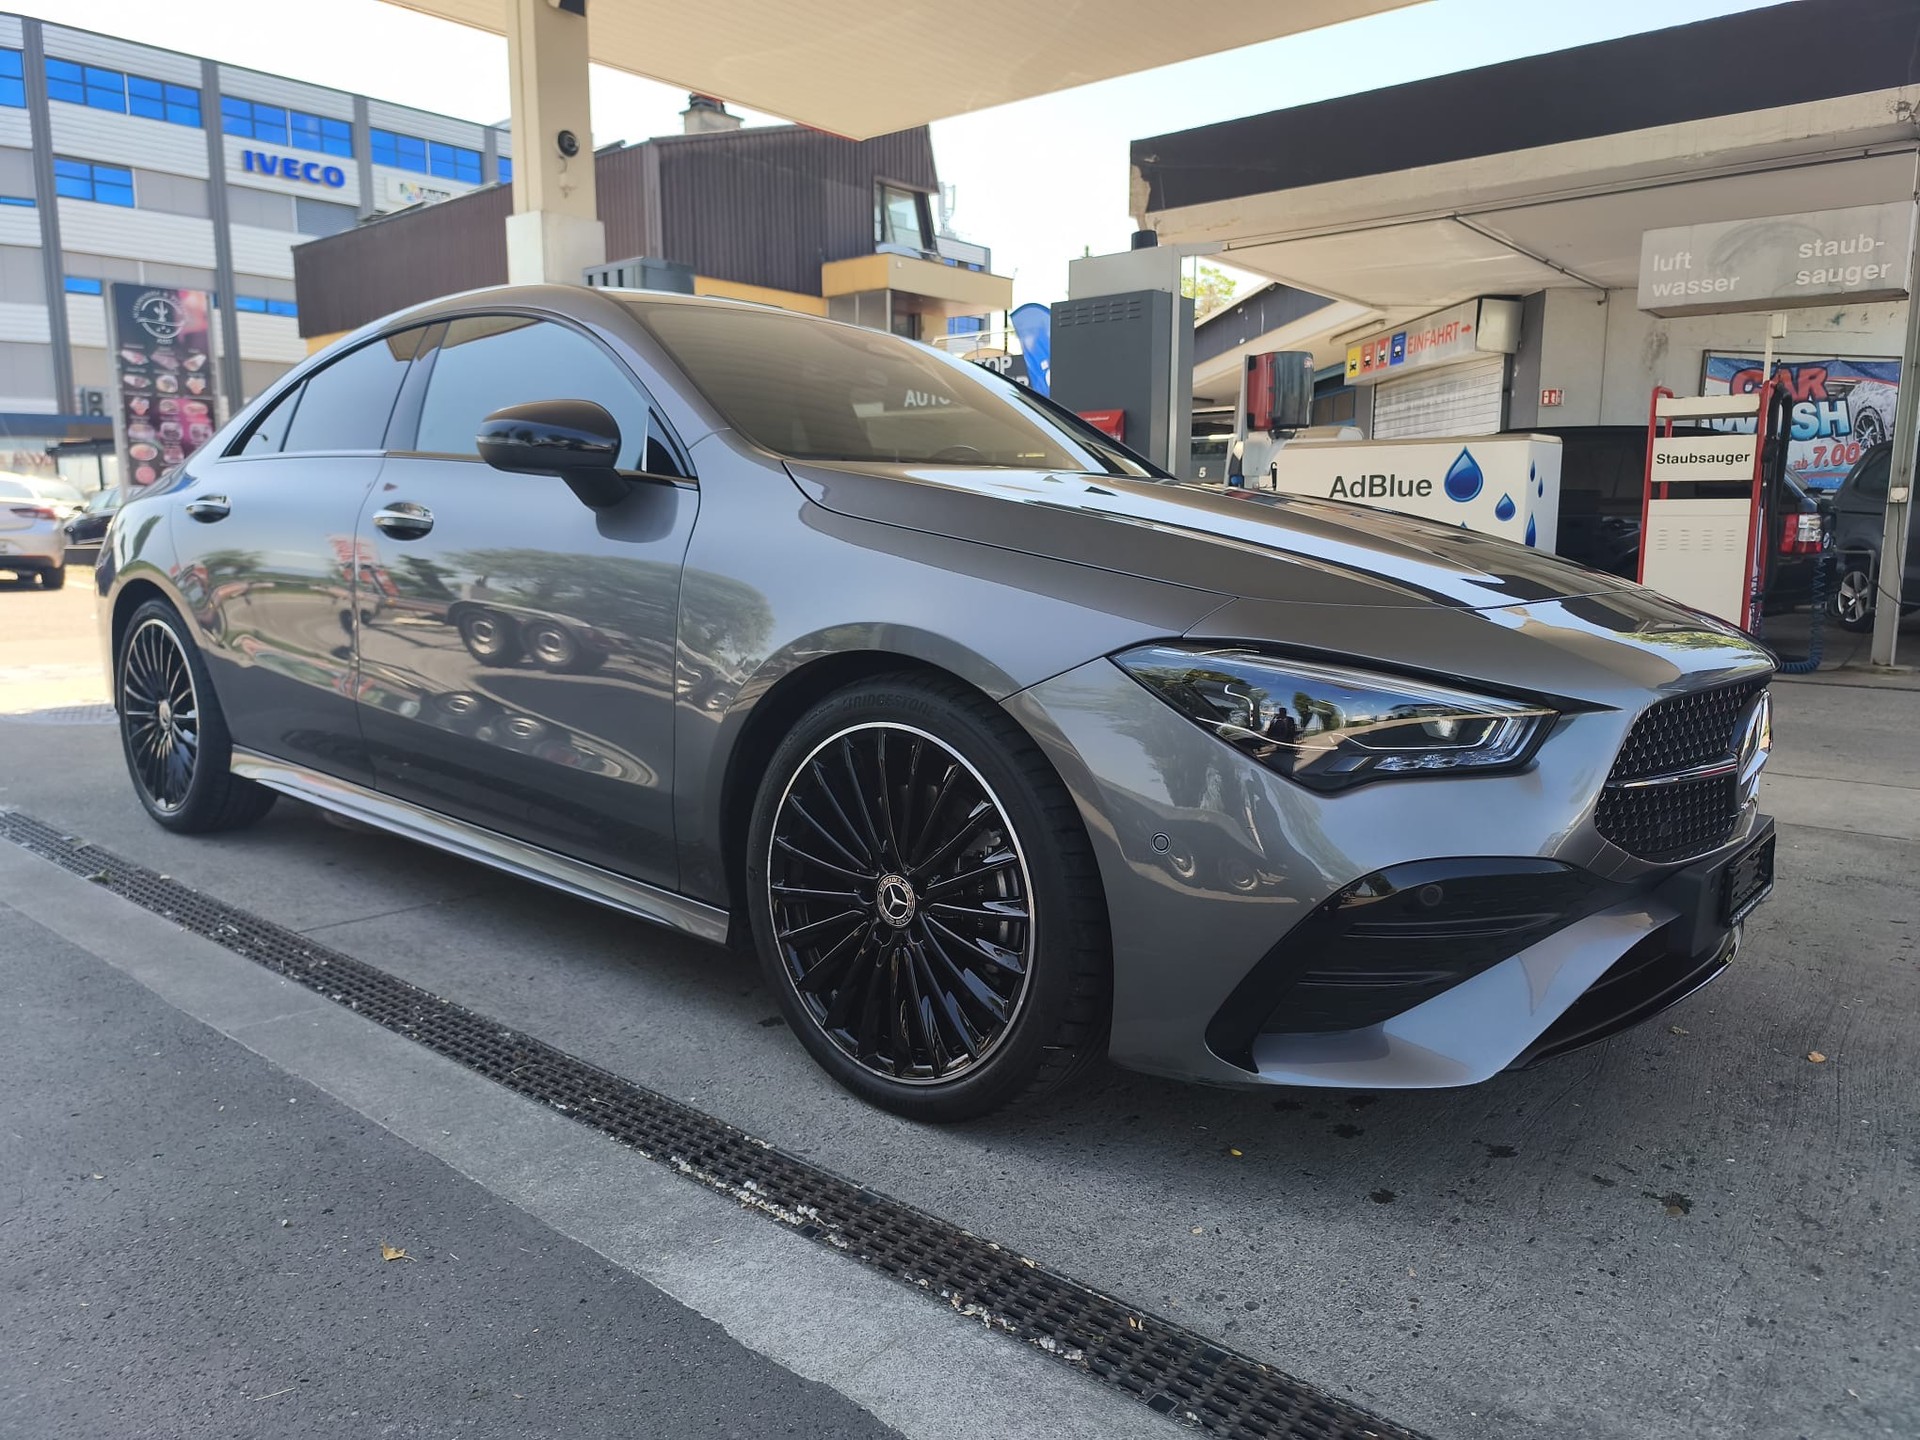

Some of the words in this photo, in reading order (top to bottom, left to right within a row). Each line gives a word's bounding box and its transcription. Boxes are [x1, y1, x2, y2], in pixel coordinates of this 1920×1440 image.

[242, 150, 346, 188] IVECO
[1798, 233, 1886, 259] staub-
[1652, 251, 1693, 272] luft
[1795, 262, 1892, 286] sauger
[1651, 275, 1740, 297] wasser
[1407, 321, 1460, 355] EINFAHRT
[1730, 367, 1828, 401] CAR
[1656, 452, 1751, 466] Staubsauger
[1813, 442, 1860, 468] 7.00
[1198, 467, 1206, 478] 5
[1329, 474, 1433, 499] AdBlue
